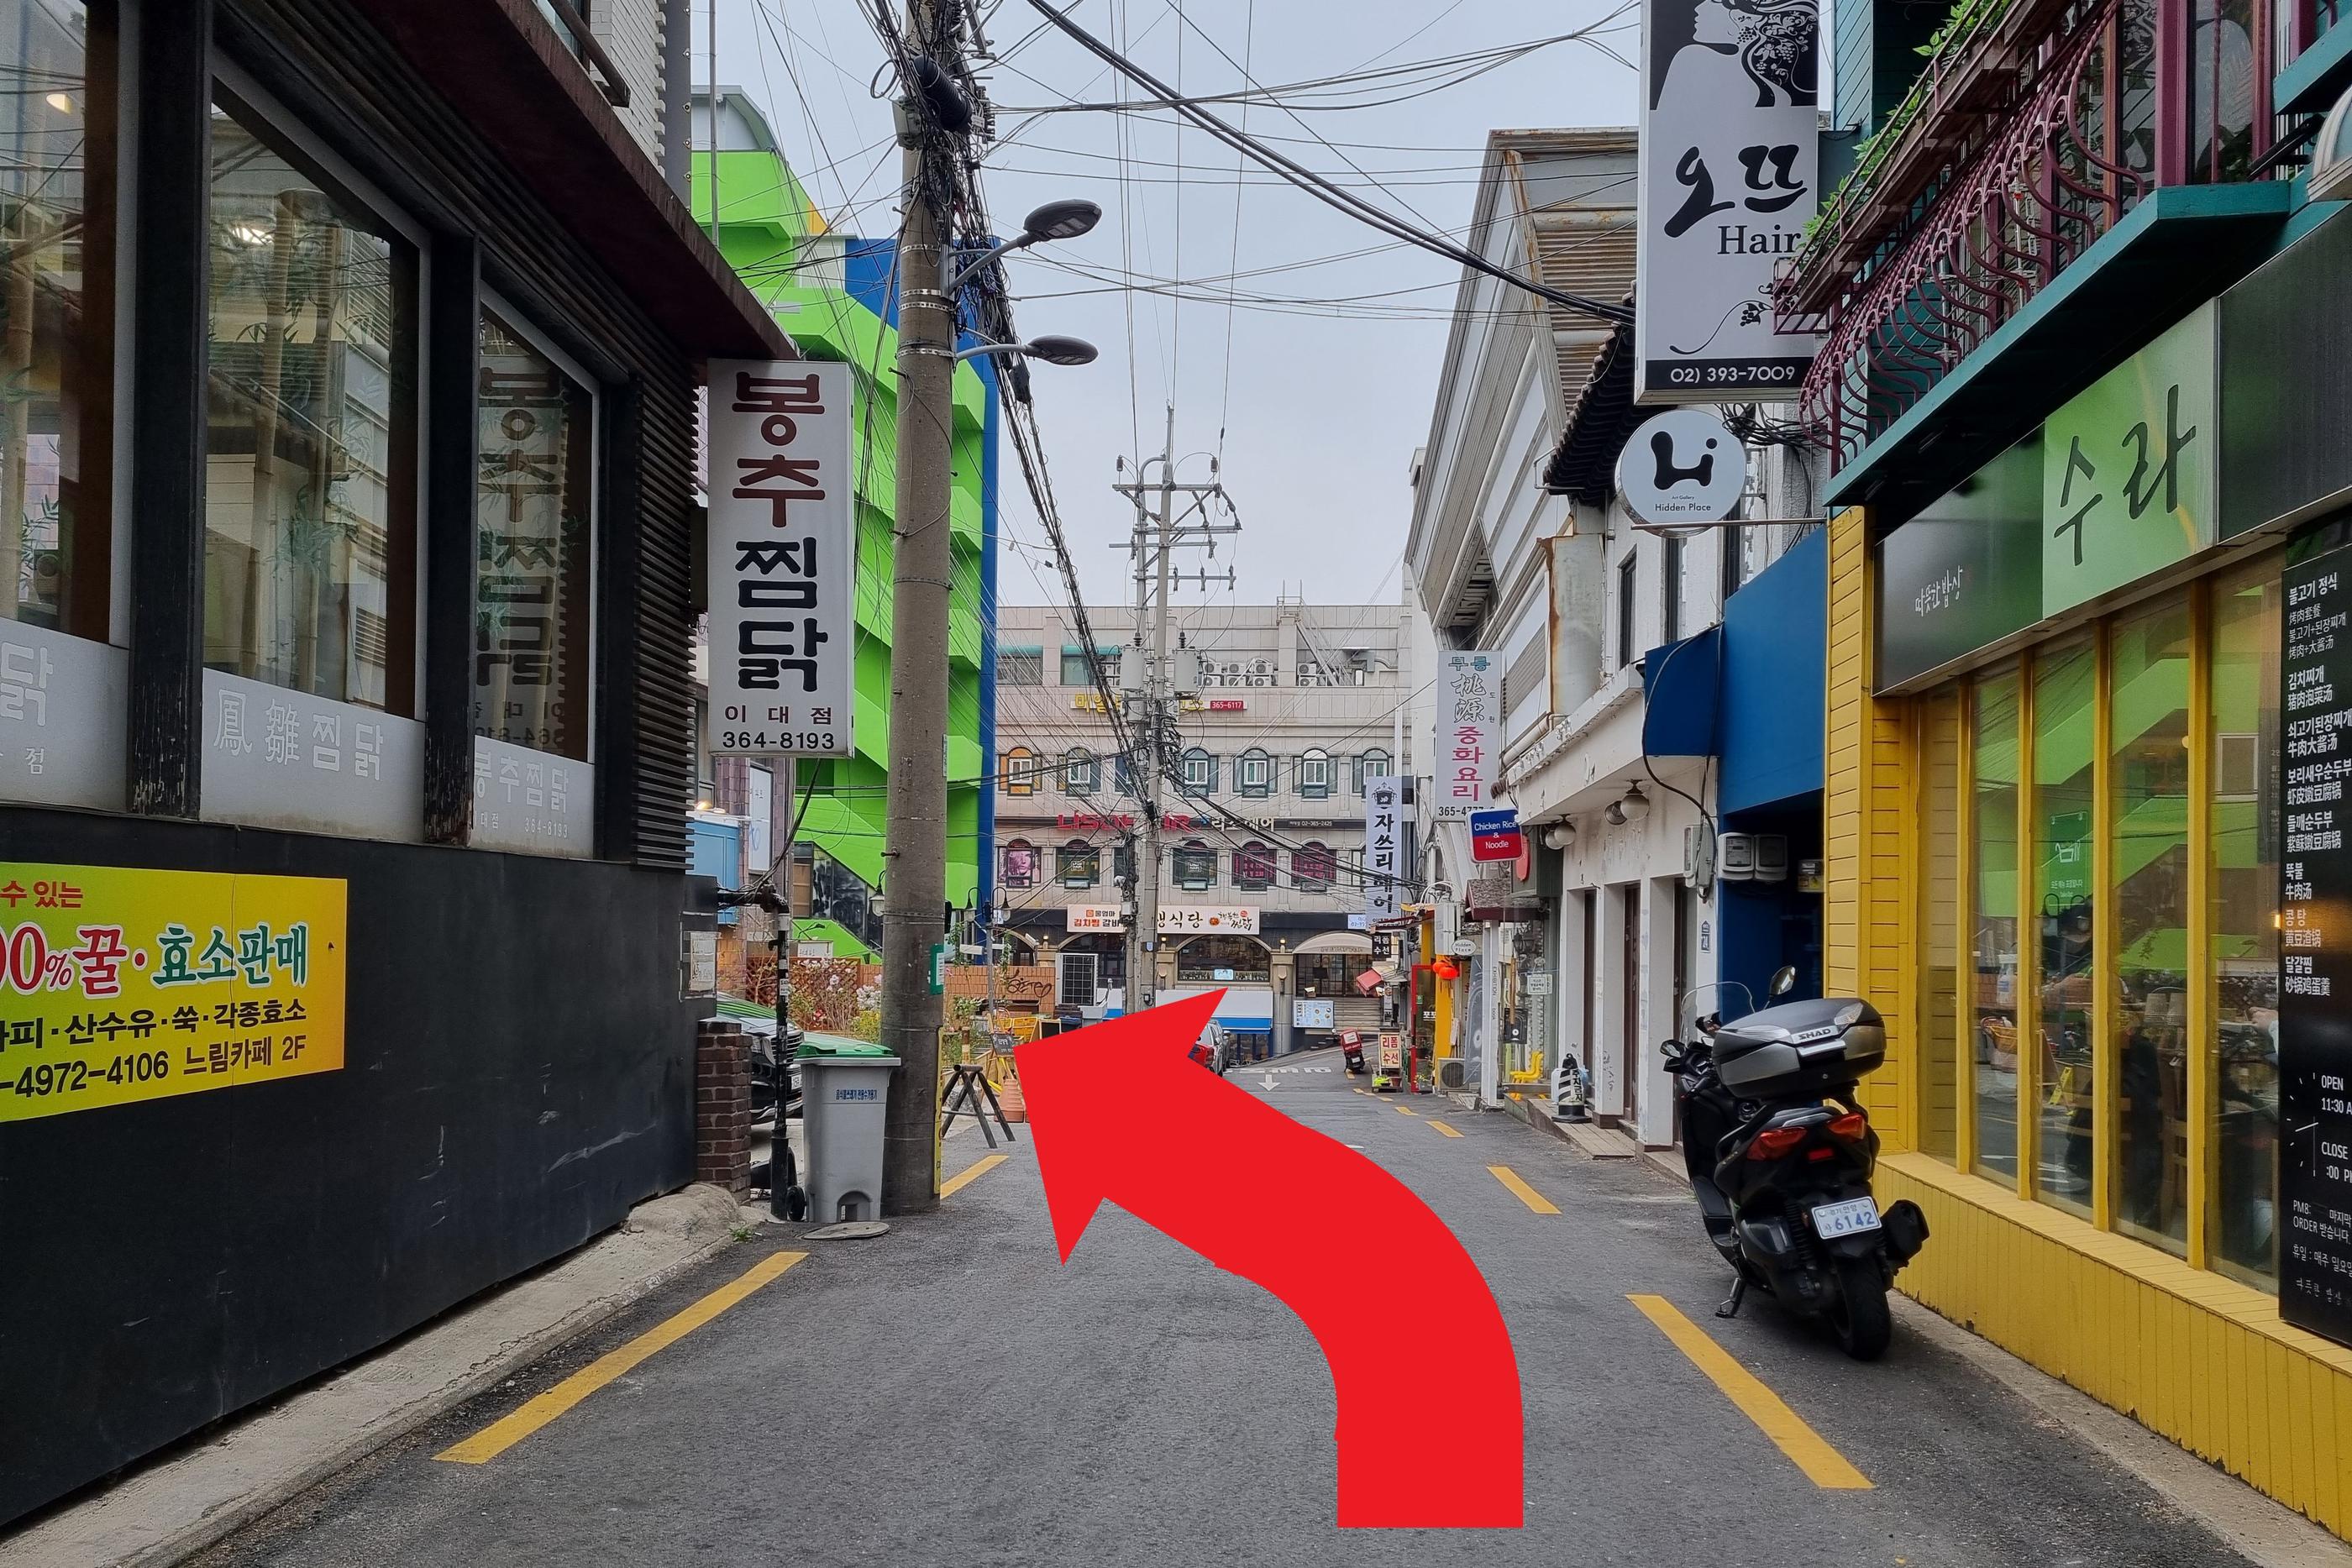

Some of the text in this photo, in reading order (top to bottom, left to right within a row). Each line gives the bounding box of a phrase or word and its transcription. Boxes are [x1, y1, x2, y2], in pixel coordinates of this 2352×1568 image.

[1717, 224, 1802, 254] Hair
[1670, 365, 1796, 385] 02) 393-7009
[2054, 383, 2197, 567] 수라
[1655, 502, 1711, 511] Hidden Place
[732, 371, 828, 693] 봉추찜닭
[2289, 572, 2338, 606] 불고기 정식
[2289, 611, 2346, 643] 불고기+된장찌개
[1448, 656, 1491, 672] 무릉
[2288, 664, 2324, 690] 김치찌개
[1451, 673, 1486, 723] 桃源
[2287, 708, 2352, 738] 쇠고기된장찌개
[722, 731, 835, 749] 364-8193
[1452, 726, 1485, 802] 중화요리
[475, 751, 569, 814] 봉추찜닭
[475, 810, 568, 838] 대점 364-8193
[1474, 820, 1517, 831] Chicken Rice
[2287, 810, 2333, 832] 들깨순두부
[1485, 841, 1509, 849] Noodle
[2286, 862, 2304, 880] 뚝불
[0, 880, 83, 908] 수 있는
[2285, 883, 2312, 901] 牛肉汤
[1074, 918, 1100, 927] 김치찜
[1373, 947, 1389, 956] 수선
[2285, 956, 2313, 973] 달걀찜
[1382, 1036, 1399, 1048] 리폼
[1798, 1027, 1831, 1041] SHAD
[183, 1036, 272, 1076] 느림카페
[281, 1035, 307, 1061] 2F
[1382, 1051, 1399, 1065] 수선
[1571, 1068, 1583, 1102] 주차금지
[2321, 1075, 2344, 1091] OPEN
[2321, 1097, 2344, 1114] 11:30
[2321, 1141, 2349, 1160] CLOSE
[1835, 1212, 1875, 1230] 6142
[2293, 1215, 2318, 1234] ORDER
[2329, 1209, 2352, 1228] 마지막
[2313, 1251, 2329, 1268] 매주
